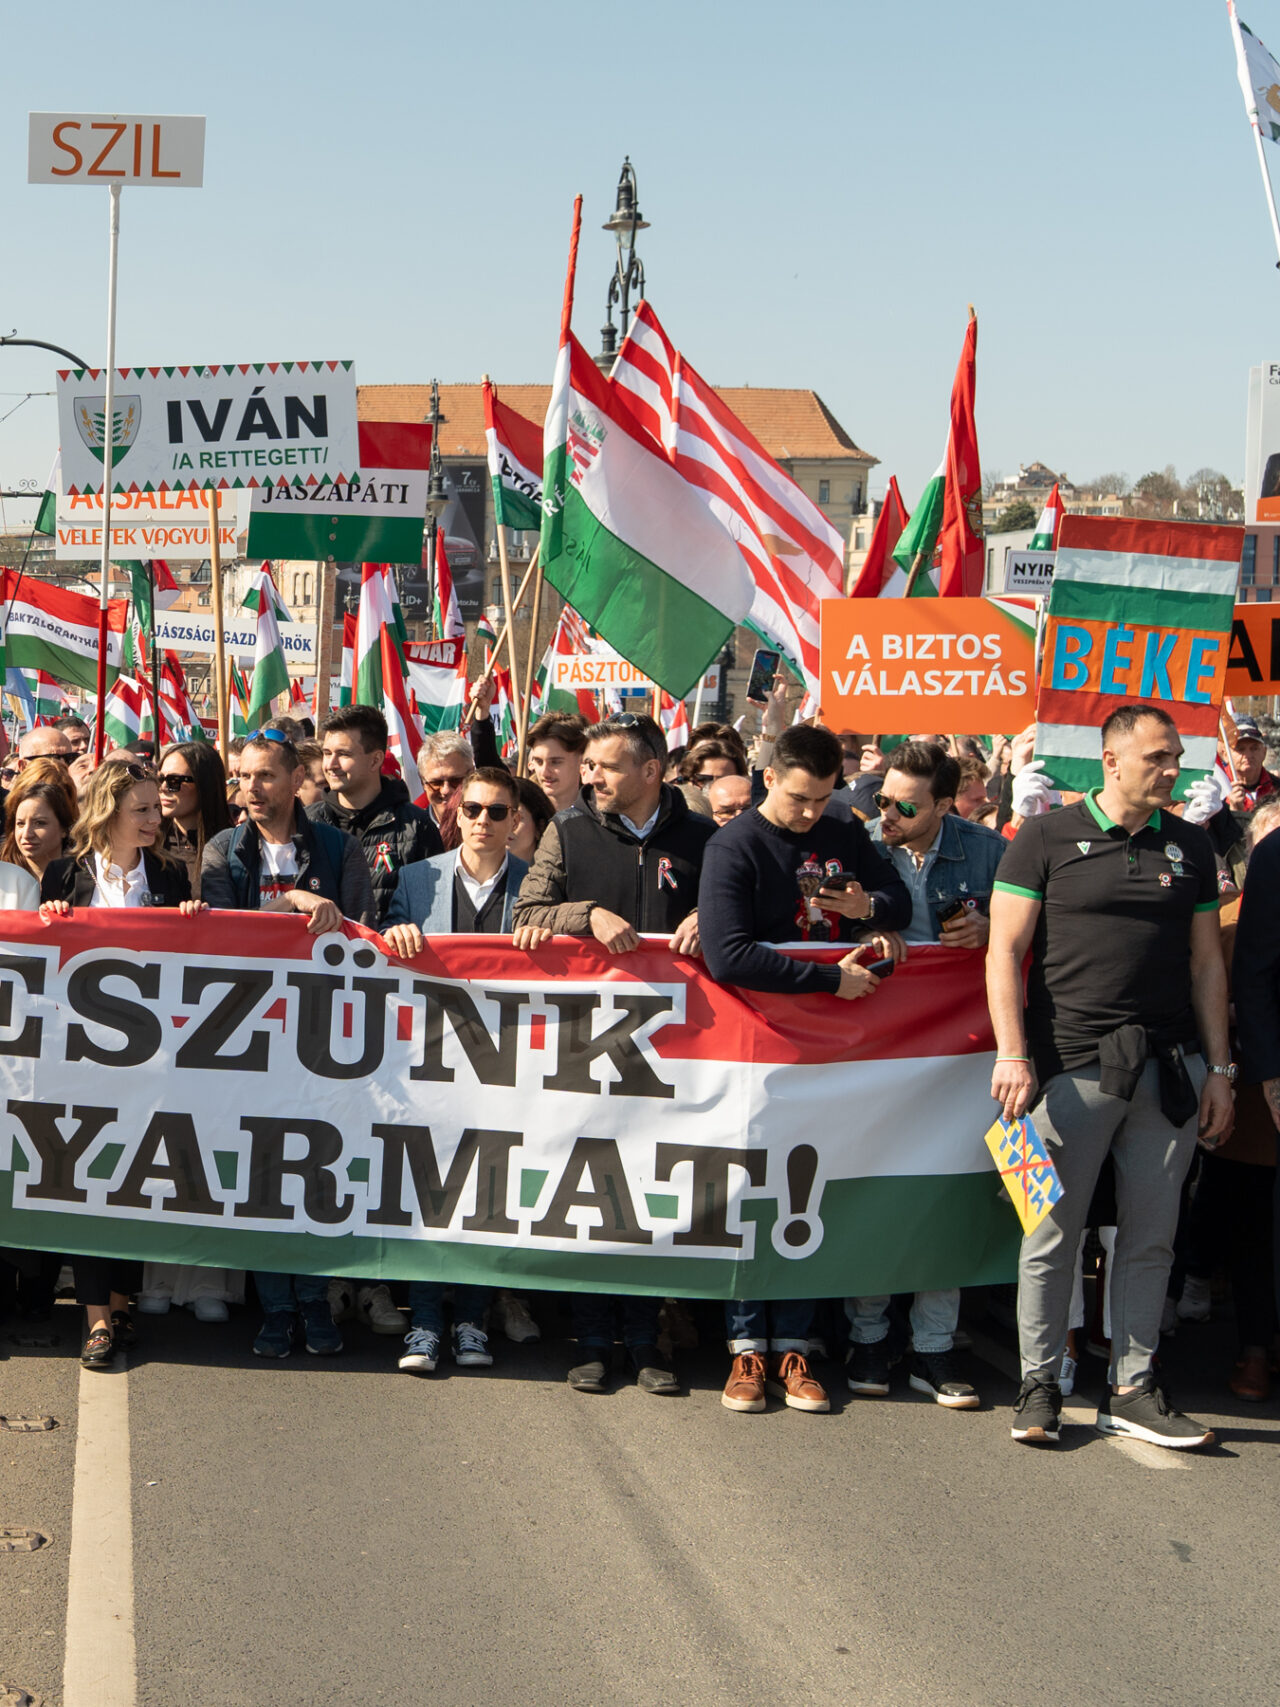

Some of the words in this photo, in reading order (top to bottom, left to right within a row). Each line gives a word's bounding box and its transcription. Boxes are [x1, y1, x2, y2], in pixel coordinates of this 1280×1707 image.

[51, 121, 181, 178] SZIL
[167, 386, 328, 444] IVÁN
[199, 447, 328, 469] RETTEGETT/
[58, 527, 137, 546] VELEEK
[141, 527, 236, 548] VAGYUK
[155, 621, 215, 643] JÁSZSÁGI
[409, 642, 457, 665] WAR
[846, 634, 870, 660] A
[882, 633, 1002, 660] BIZTOS
[1051, 621, 1220, 705] BÉKE
[831, 663, 1027, 696] VÁLASZTÁS
